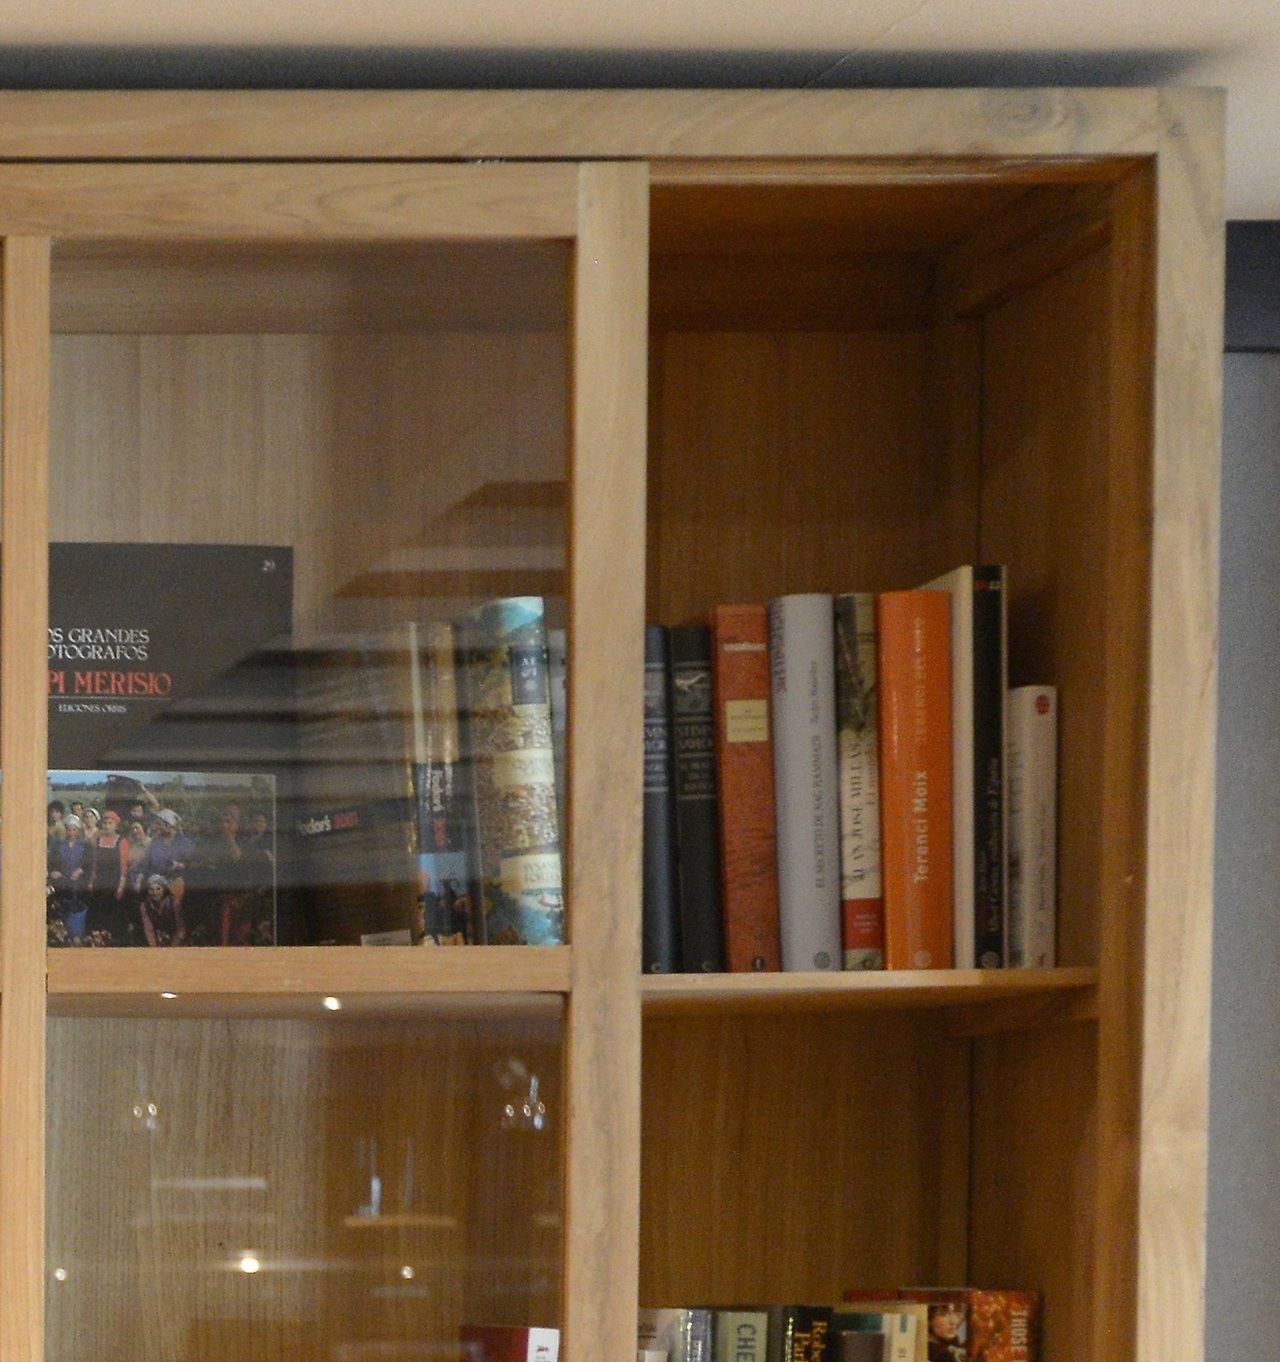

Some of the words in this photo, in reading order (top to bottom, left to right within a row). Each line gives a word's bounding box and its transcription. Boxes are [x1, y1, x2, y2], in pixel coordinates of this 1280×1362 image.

[68, 628, 150, 644] GRANDES
[74, 671, 172, 695] MERISIO
[914, 771, 928, 813] Moix
[914, 820, 929, 883] Terenci
[1011, 1310, 1028, 1354] THOSE
